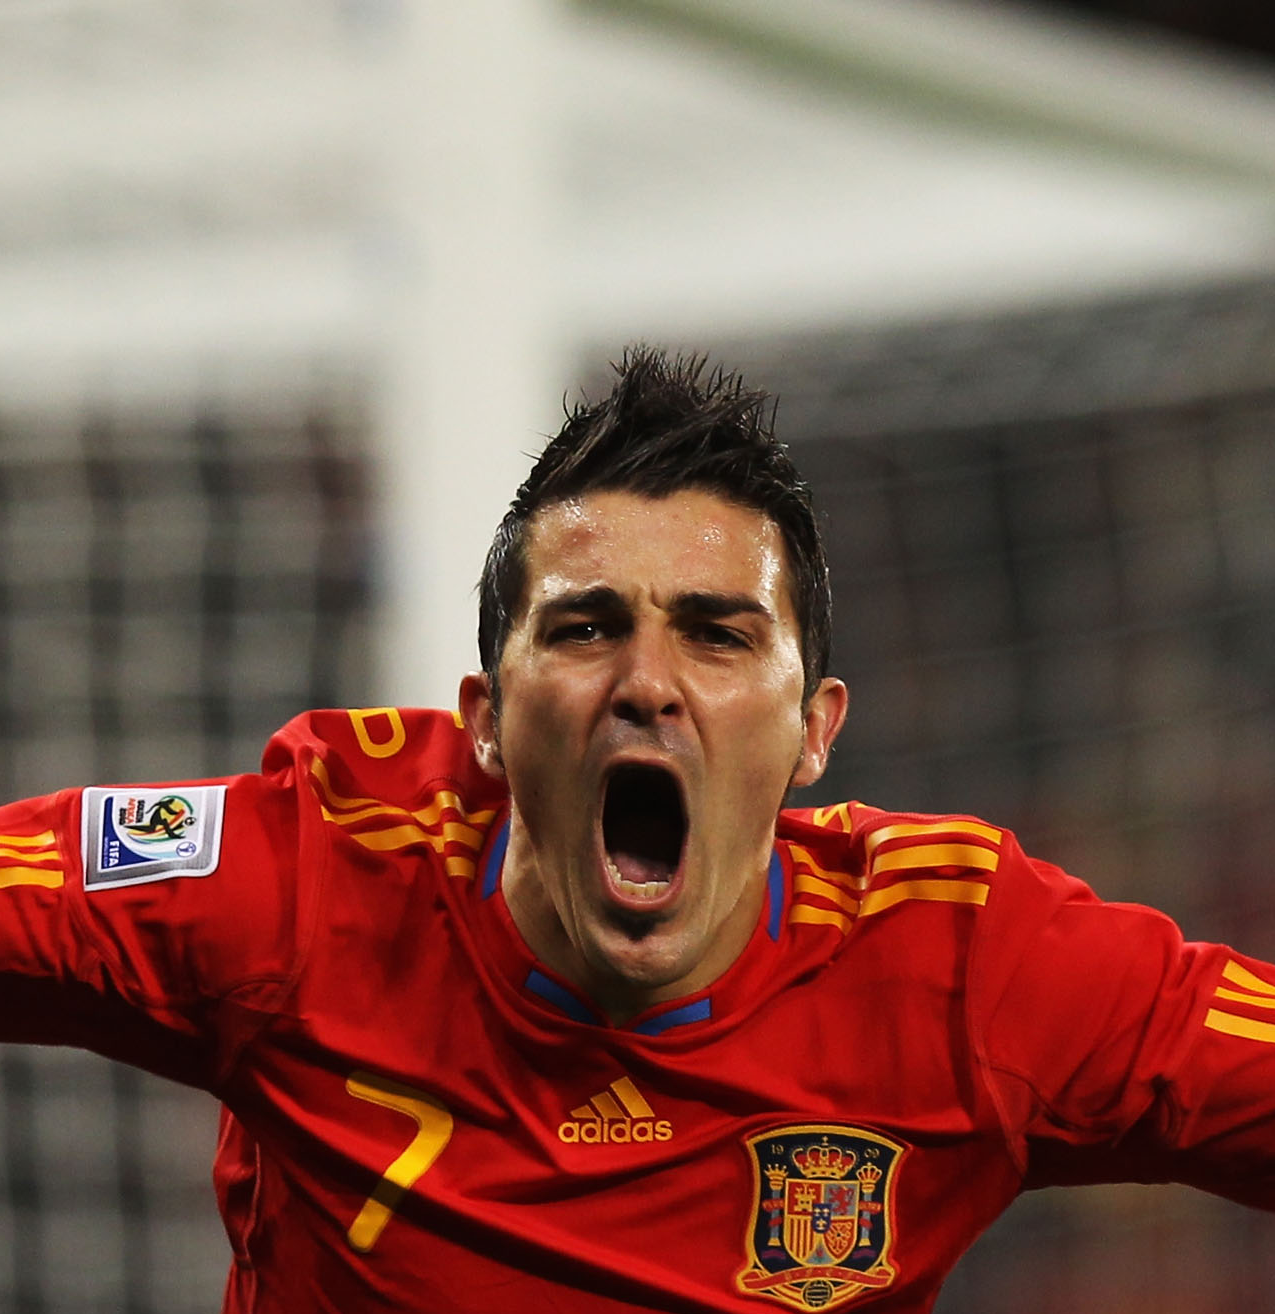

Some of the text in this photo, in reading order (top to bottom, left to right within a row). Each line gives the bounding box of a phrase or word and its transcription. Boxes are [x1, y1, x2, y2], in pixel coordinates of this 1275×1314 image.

[109, 841, 120, 867] FIFA
[558, 1117, 673, 1143] adidas
[346, 1071, 453, 1253] 7
